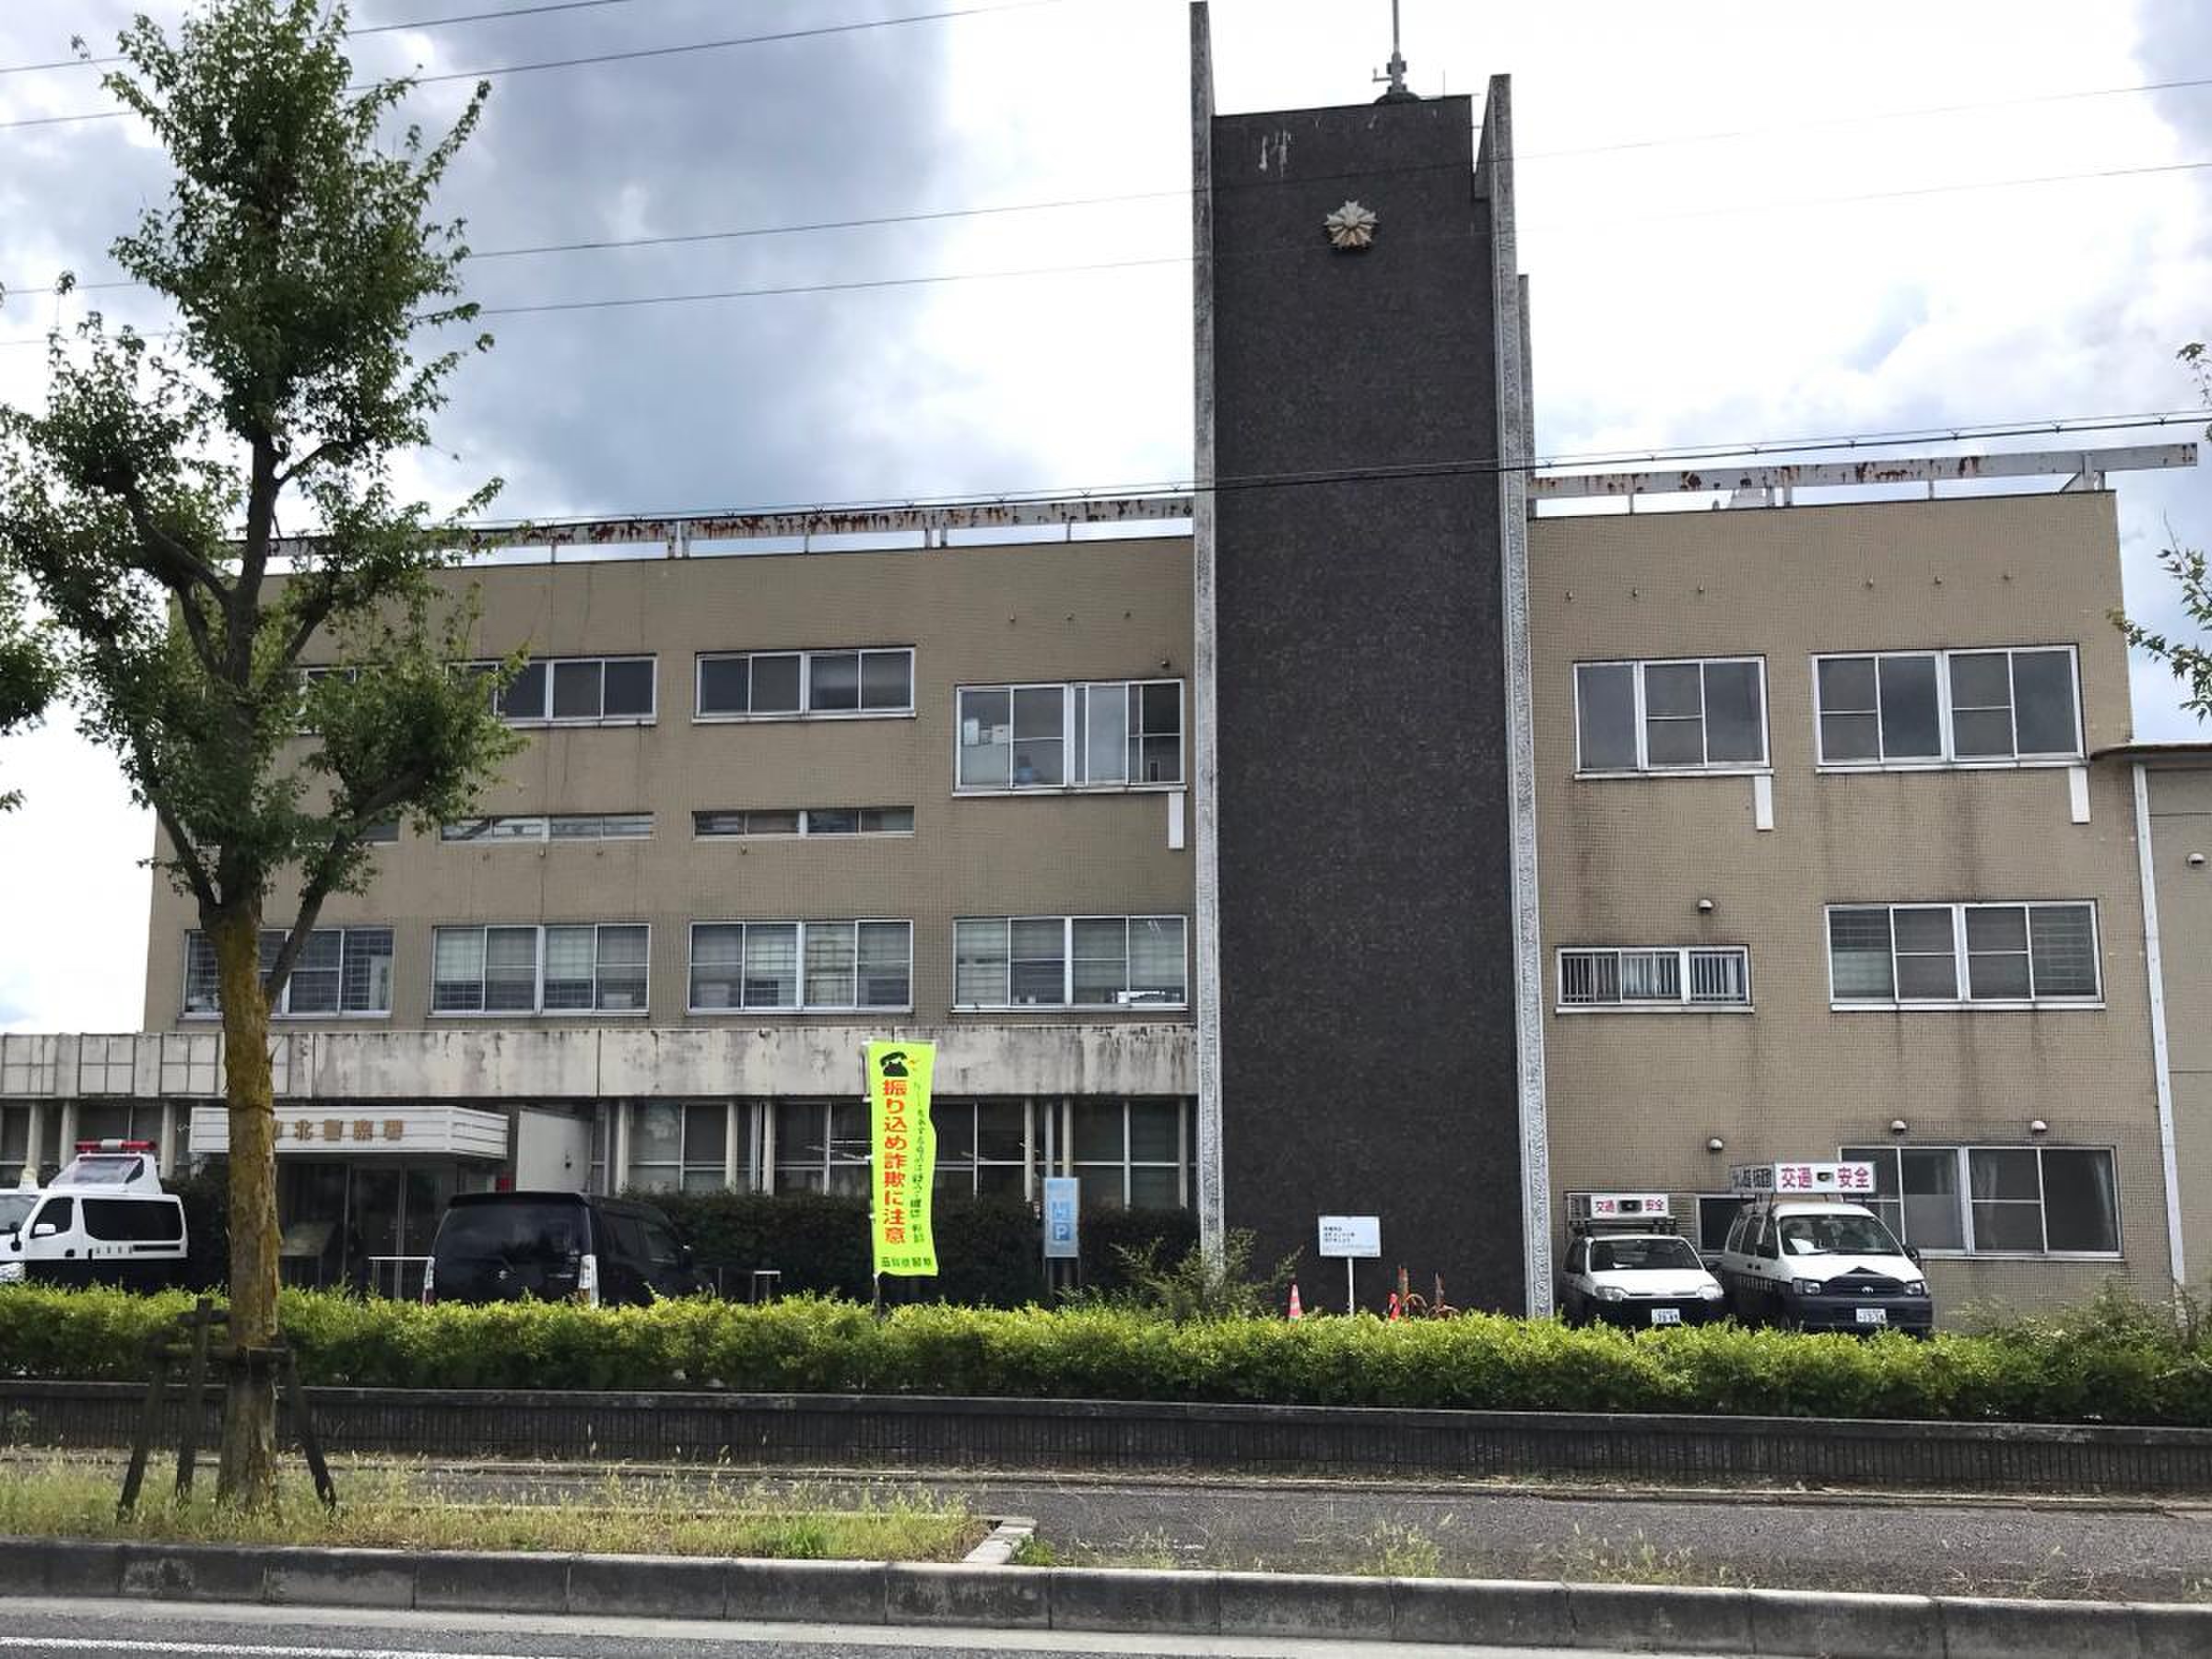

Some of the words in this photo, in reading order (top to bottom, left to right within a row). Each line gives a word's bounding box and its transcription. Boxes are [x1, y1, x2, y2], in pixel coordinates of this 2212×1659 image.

[882, 1079, 908, 1245] 振り込め詐欺に注意
[1781, 1167, 1813, 1189] 交通
[1837, 1167, 1870, 1189] 安全
